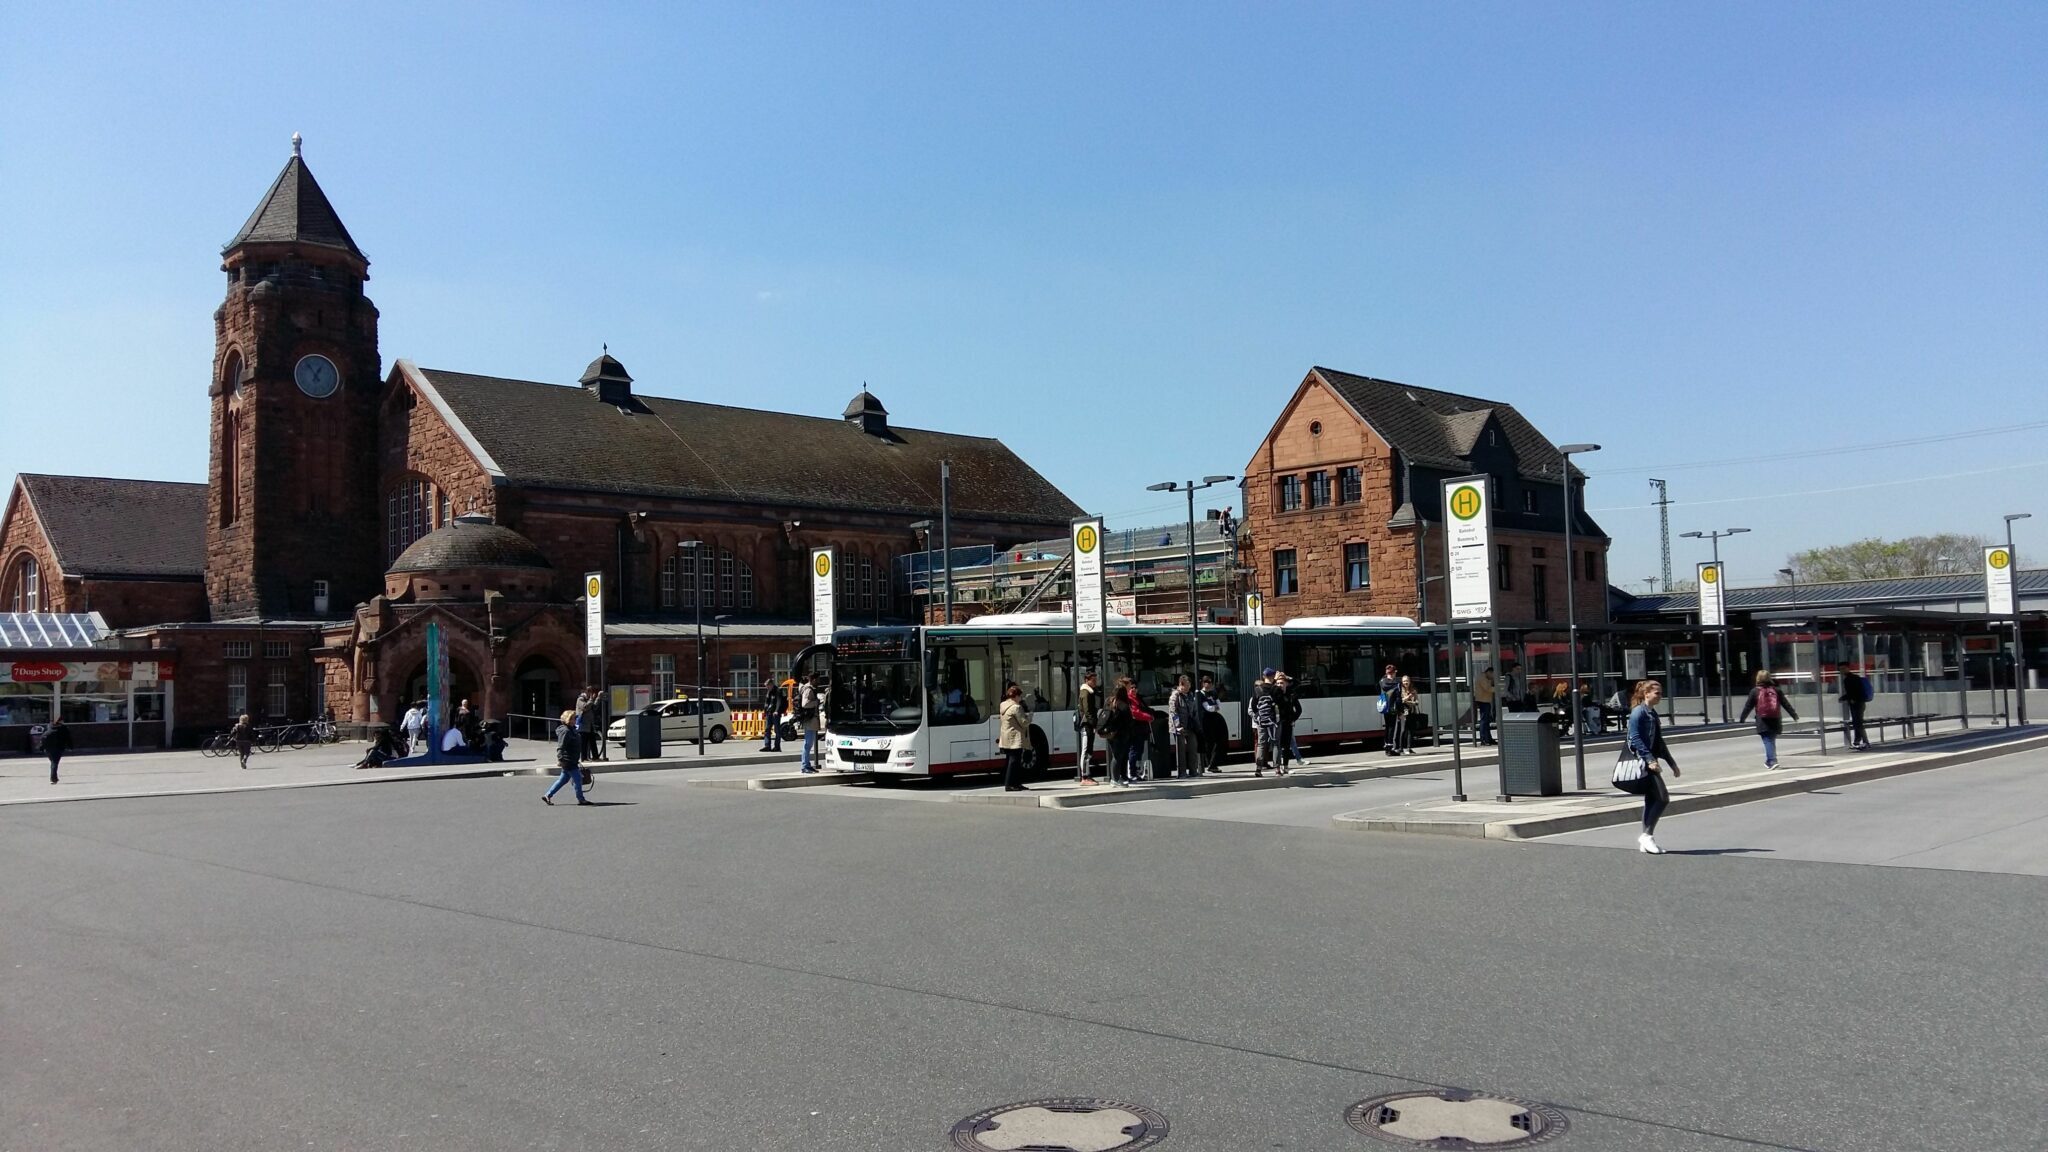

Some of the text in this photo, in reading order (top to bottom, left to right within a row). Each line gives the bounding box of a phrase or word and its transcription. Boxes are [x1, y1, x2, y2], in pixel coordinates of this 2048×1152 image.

[1459, 492, 1473, 514] H
[1082, 530, 1091, 549] H
[819, 558, 826, 572] H
[1994, 553, 2004, 565] H
[14, 667, 62, 677] 7 Days Shop
[1613, 758, 1646, 783] NIK
